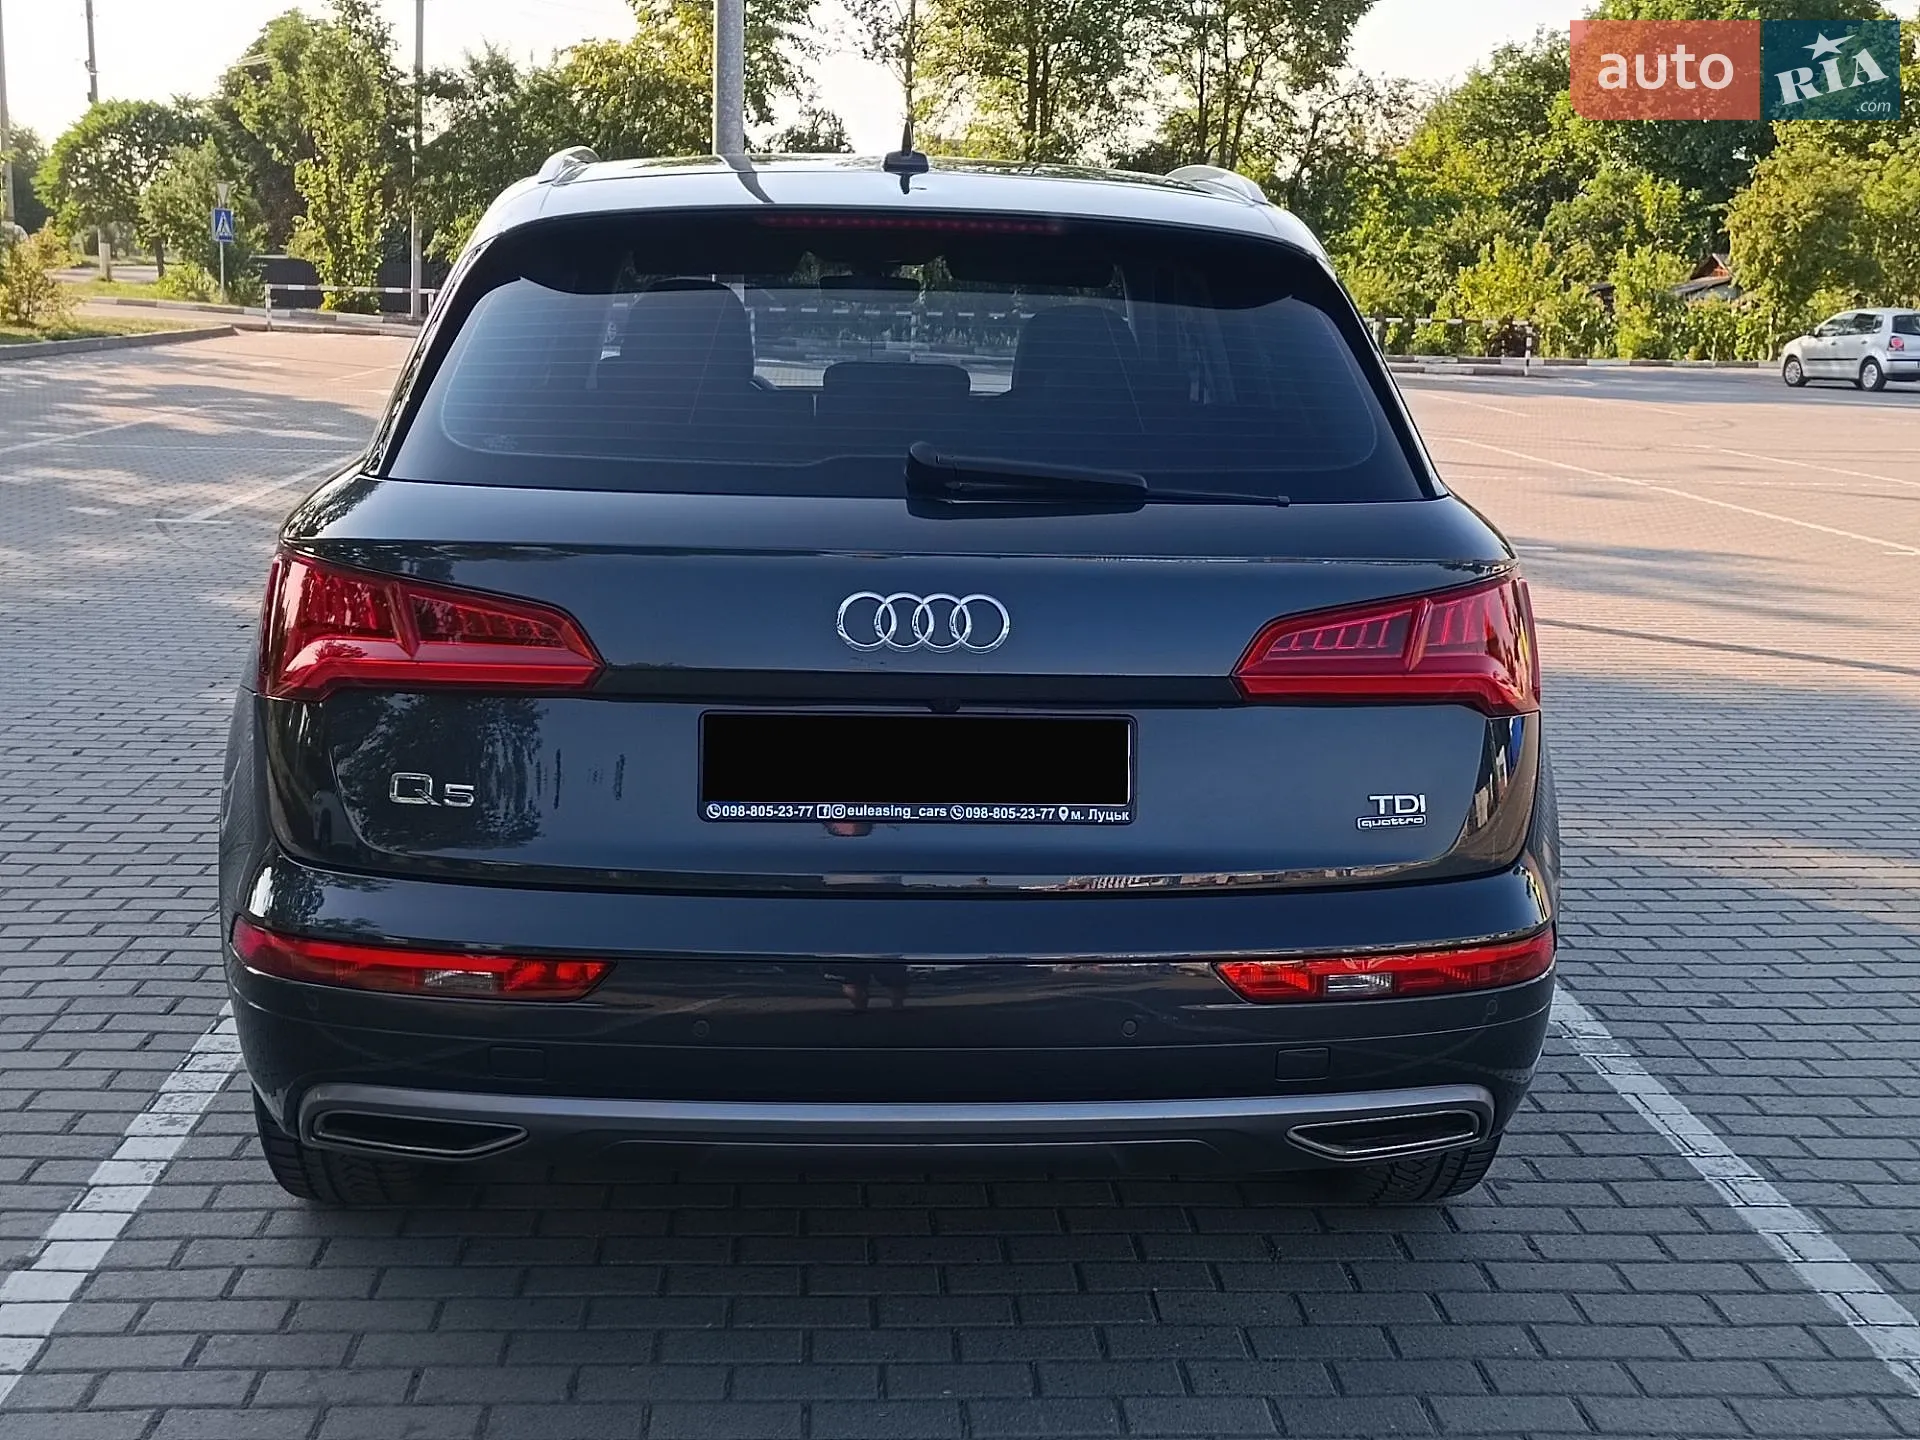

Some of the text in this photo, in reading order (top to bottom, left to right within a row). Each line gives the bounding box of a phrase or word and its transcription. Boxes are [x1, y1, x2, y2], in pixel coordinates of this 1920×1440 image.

[389, 772, 475, 807] Q5
[722, 804, 1130, 823] 098-805-23-77 euleasing_cars 098-805-23-77 м. Луцьк
[1369, 794, 1426, 815] TDI
[1361, 817, 1424, 829] quattro
